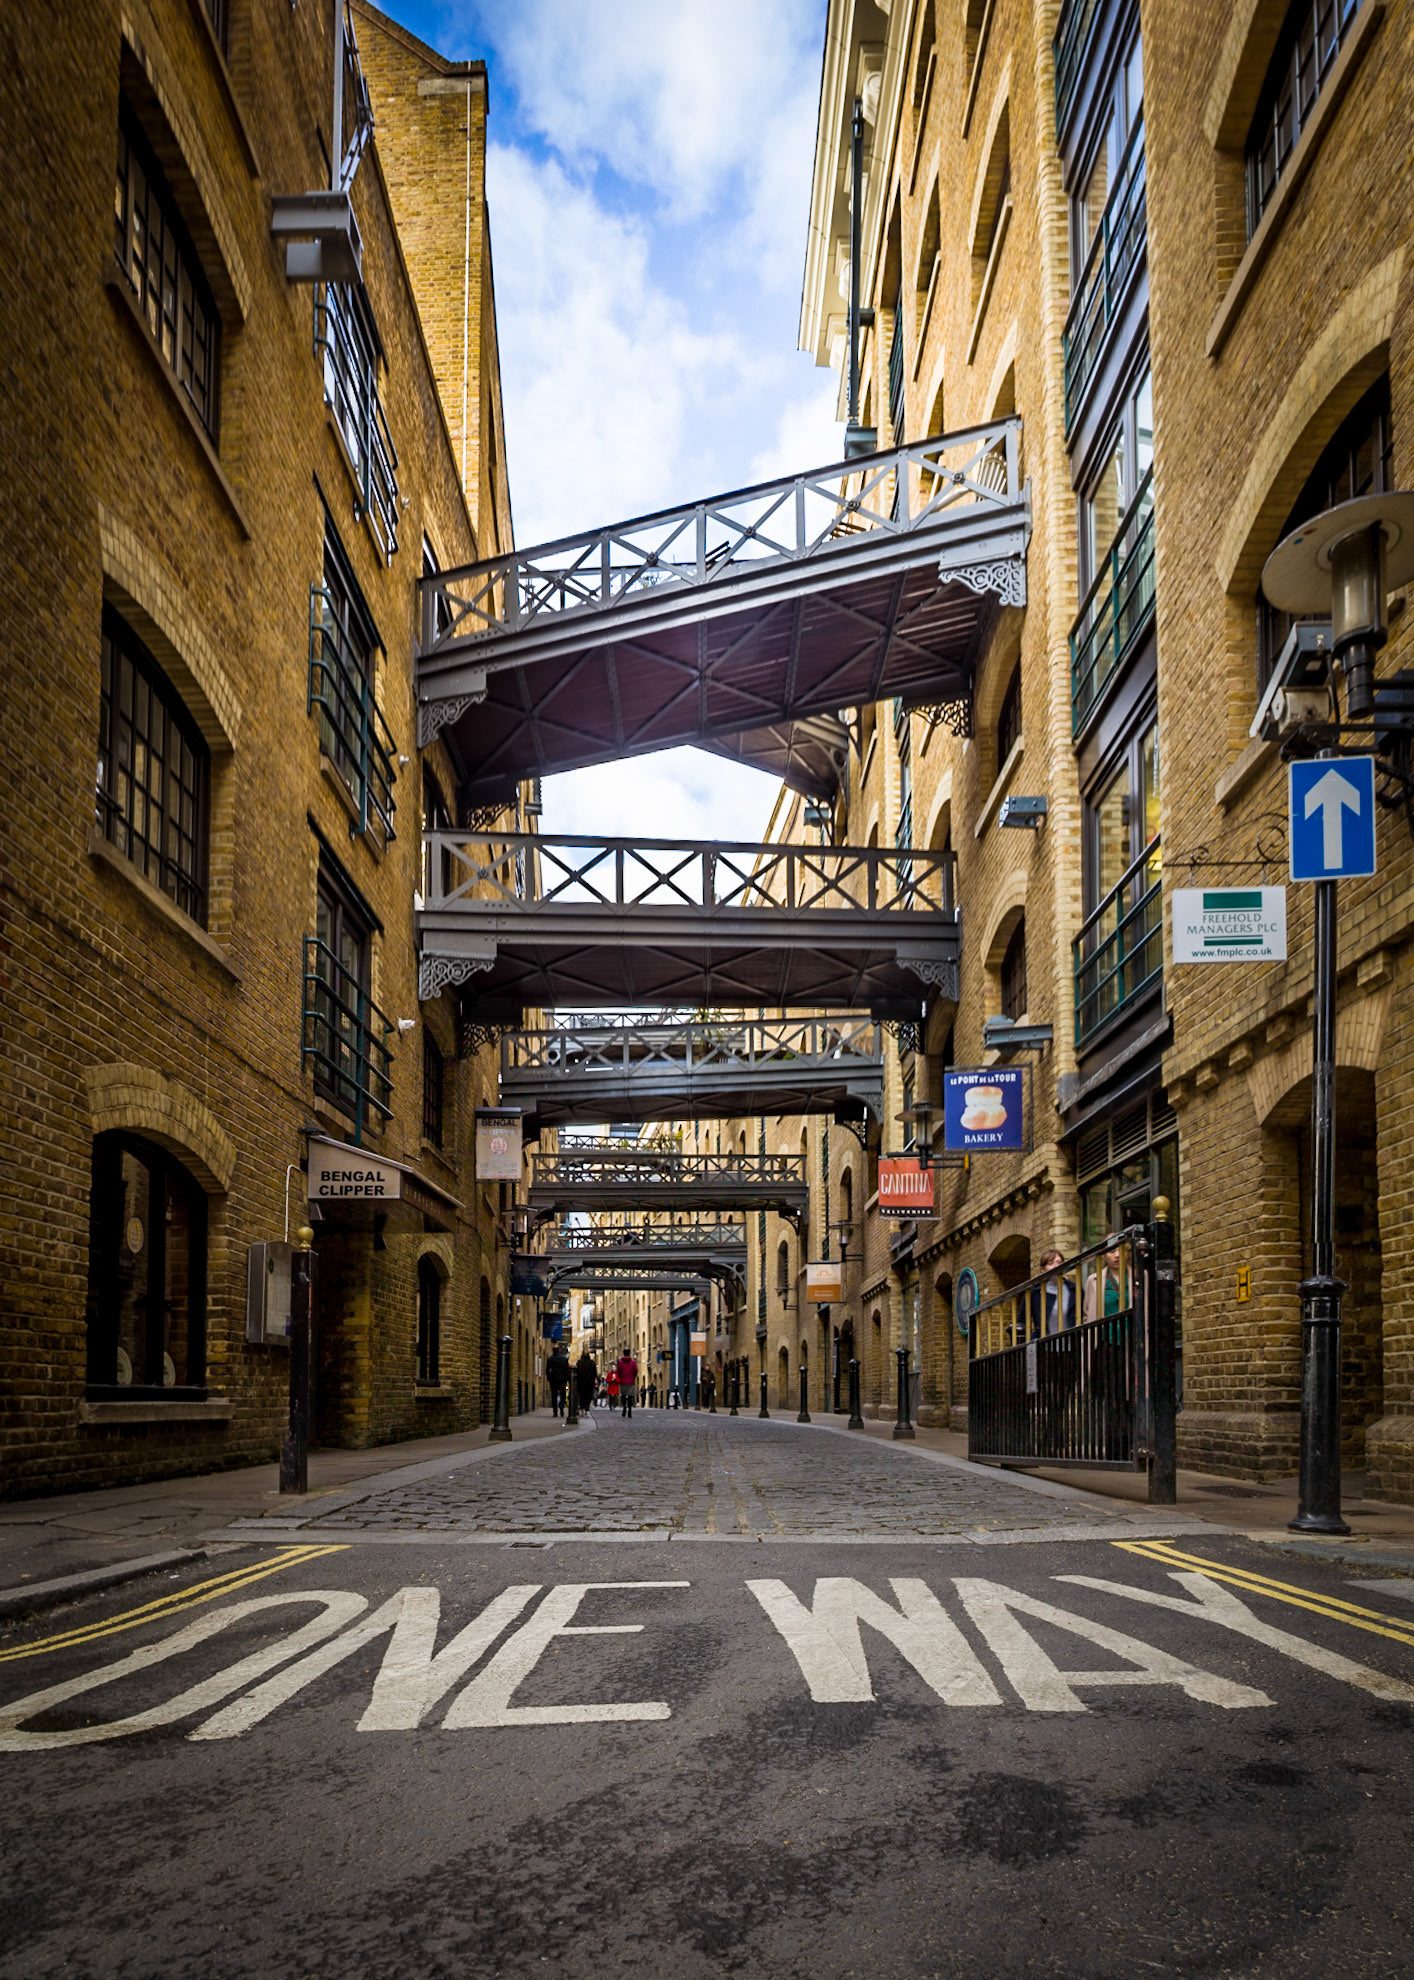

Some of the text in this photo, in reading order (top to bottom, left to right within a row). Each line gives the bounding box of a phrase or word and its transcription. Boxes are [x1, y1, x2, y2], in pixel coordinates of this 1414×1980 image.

[1202, 913, 1262, 924] FREEHOLD
[1186, 923, 1278, 935] MANAGERS PLC
[1191, 947, 1273, 958] www.fmplc.co.uk
[950, 1078, 957, 1086] LE
[957, 1074, 979, 1085] PONT
[979, 1076, 986, 1084] DE
[994, 1073, 1017, 1082] TOUR
[481, 1118, 518, 1127] BENGAL
[964, 1133, 1004, 1143] BAKERY
[320, 1170, 386, 1182] BENGAL
[880, 1172, 932, 1196] CANTINA
[319, 1185, 385, 1196] CLIPPER
[0, 1571, 1414, 1753] ONE WAY
